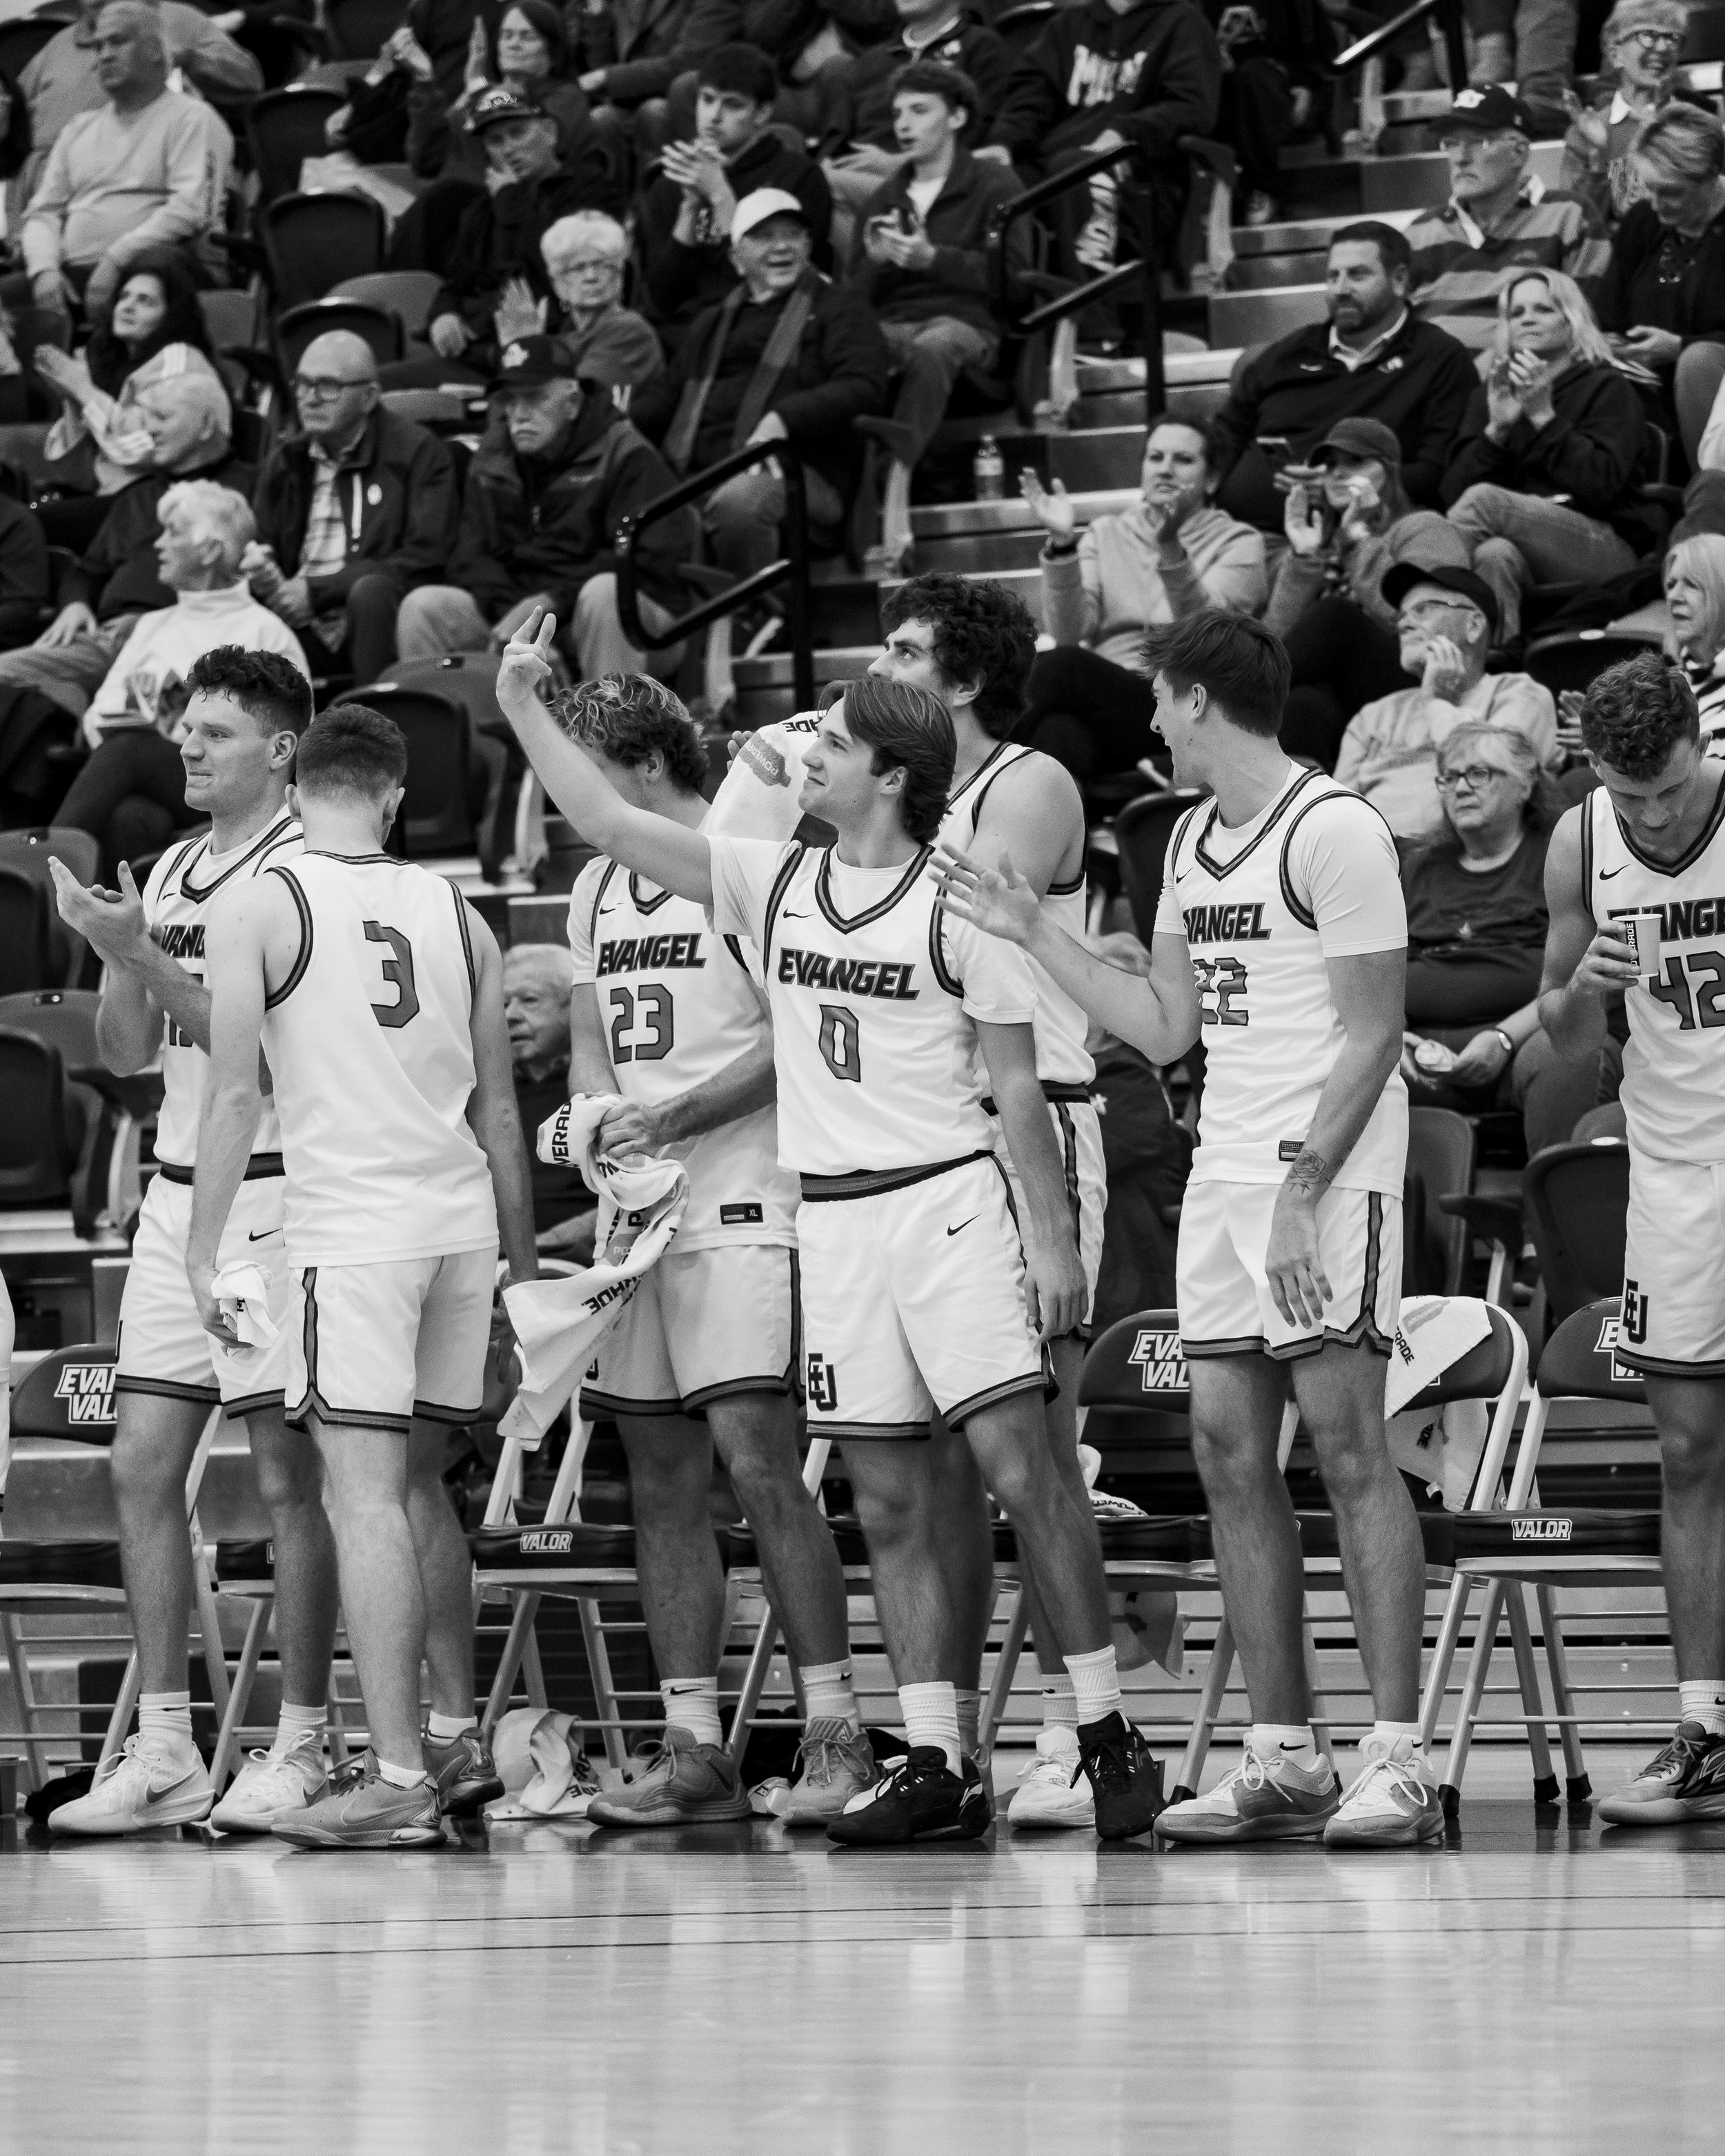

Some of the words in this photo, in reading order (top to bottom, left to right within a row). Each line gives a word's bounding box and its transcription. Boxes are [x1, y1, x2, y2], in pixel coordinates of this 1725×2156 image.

[1183, 902, 1272, 945] VANGEL
[362, 920, 420, 1029] 3
[596, 933, 707, 978] EVANGEL
[778, 947, 920, 1000] EVANGEL
[1192, 957, 1249, 1026] 22
[1649, 950, 1725, 1030] 42
[610, 983, 674, 1065] 23
[818, 1004, 861, 1082] 0
[748, 1209, 758, 1217] XL
[72, 1394, 118, 1420] VAL
[522, 1534, 571, 1550] VALOR
[1514, 1521, 1570, 1538] VALOR
